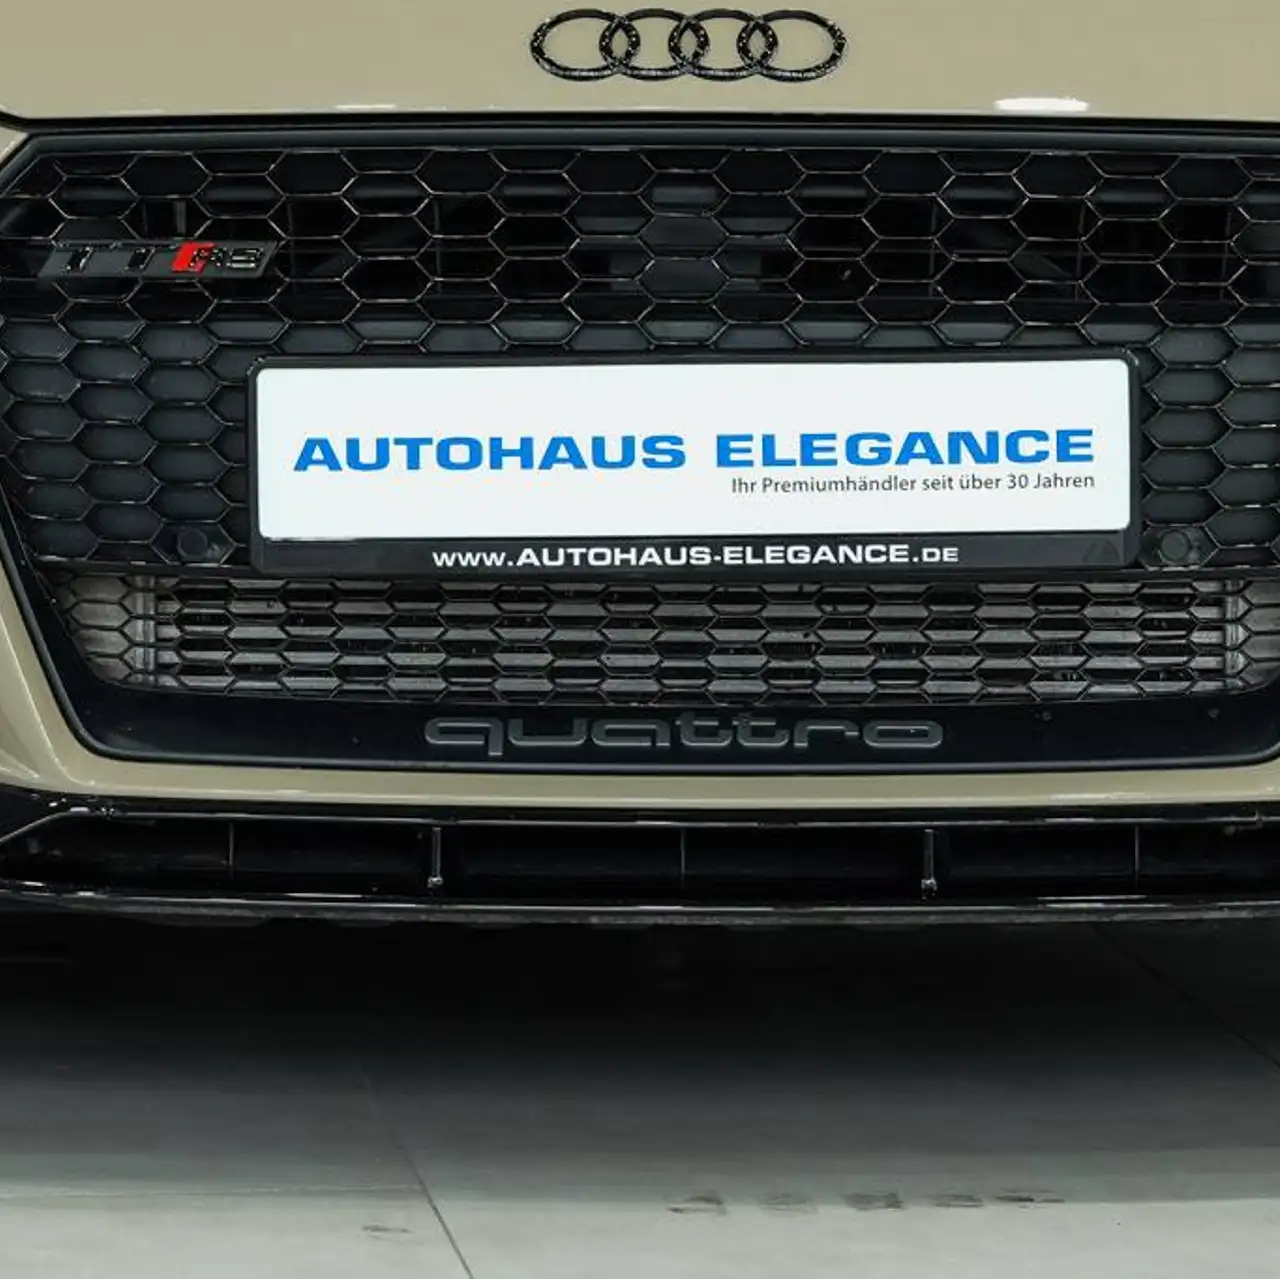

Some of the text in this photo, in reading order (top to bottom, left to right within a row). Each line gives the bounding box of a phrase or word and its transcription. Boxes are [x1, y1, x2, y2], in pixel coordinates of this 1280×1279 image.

[295, 428, 1094, 473] AUTOHAUS ELEGANCE
[732, 472, 1095, 493] Ihr Premiumhändler seit über 30 Jahren
[423, 711, 945, 757] quattro
